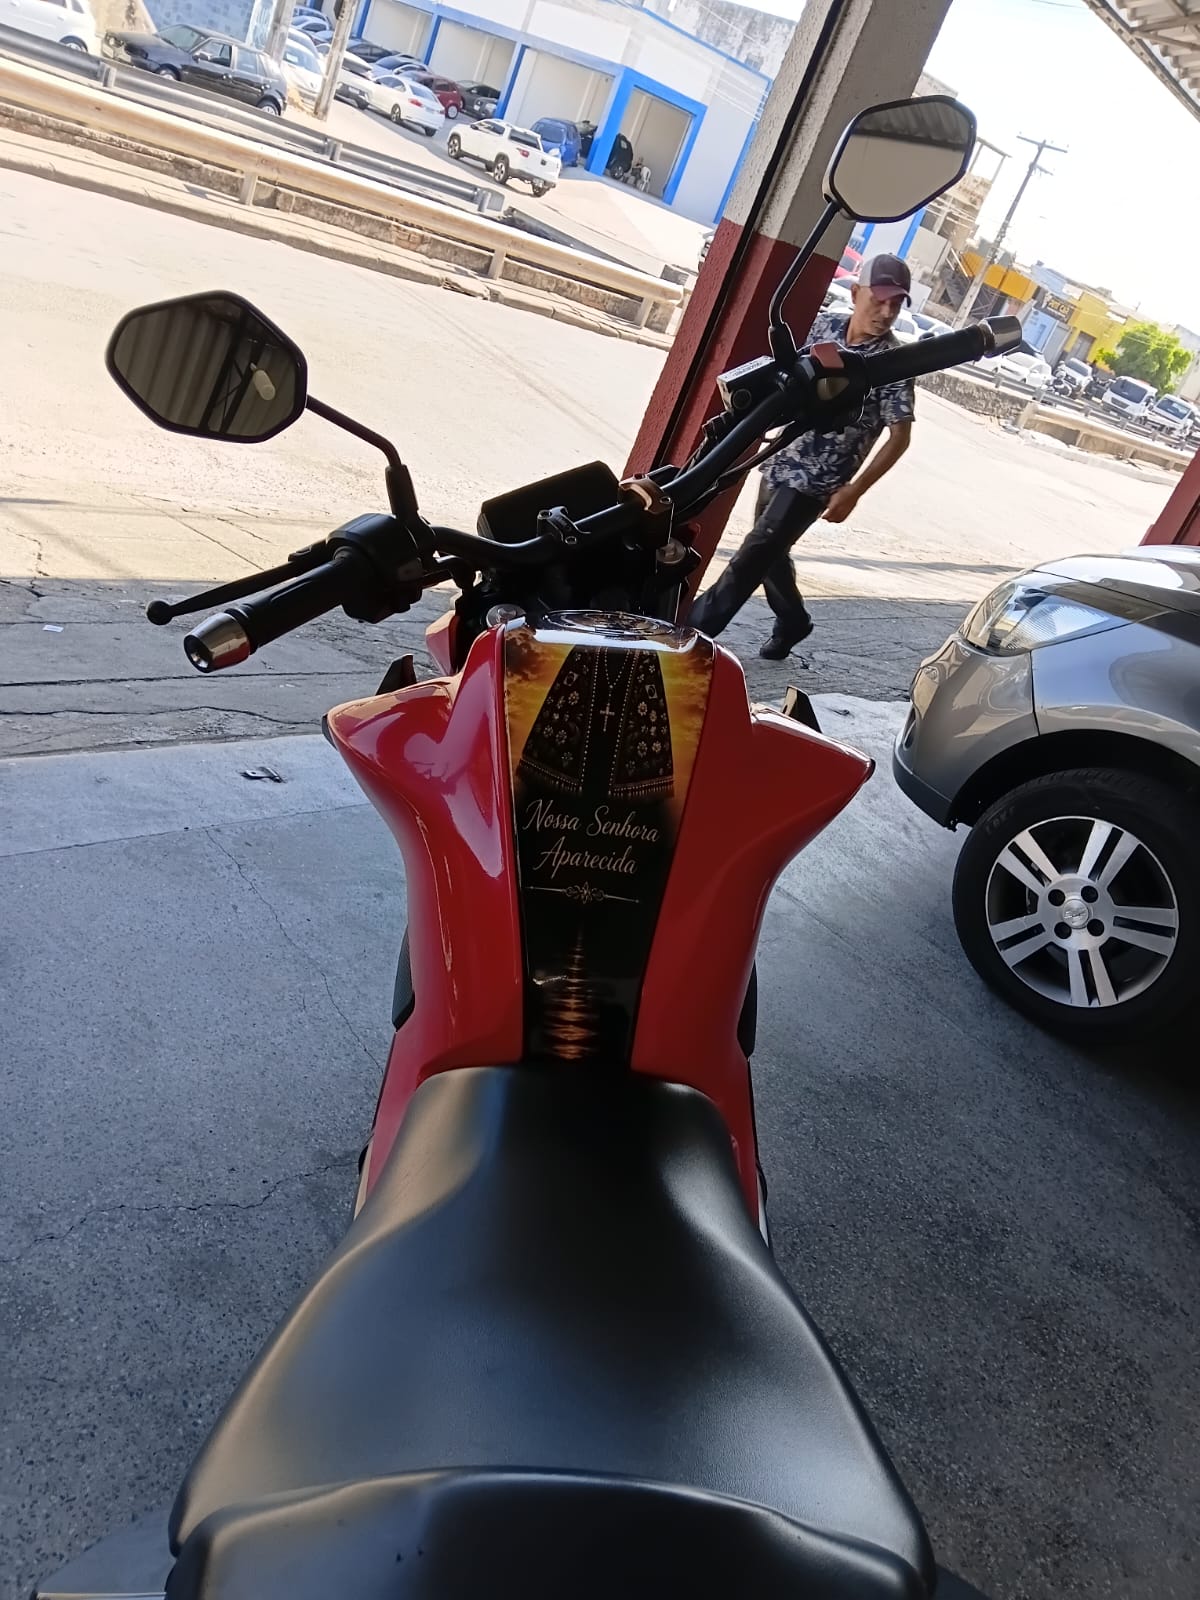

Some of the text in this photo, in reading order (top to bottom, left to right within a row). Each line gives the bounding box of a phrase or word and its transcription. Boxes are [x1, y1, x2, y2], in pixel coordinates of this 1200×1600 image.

[522, 799, 660, 842] Nossa Senhora
[532, 835, 637, 879] Aparecida
